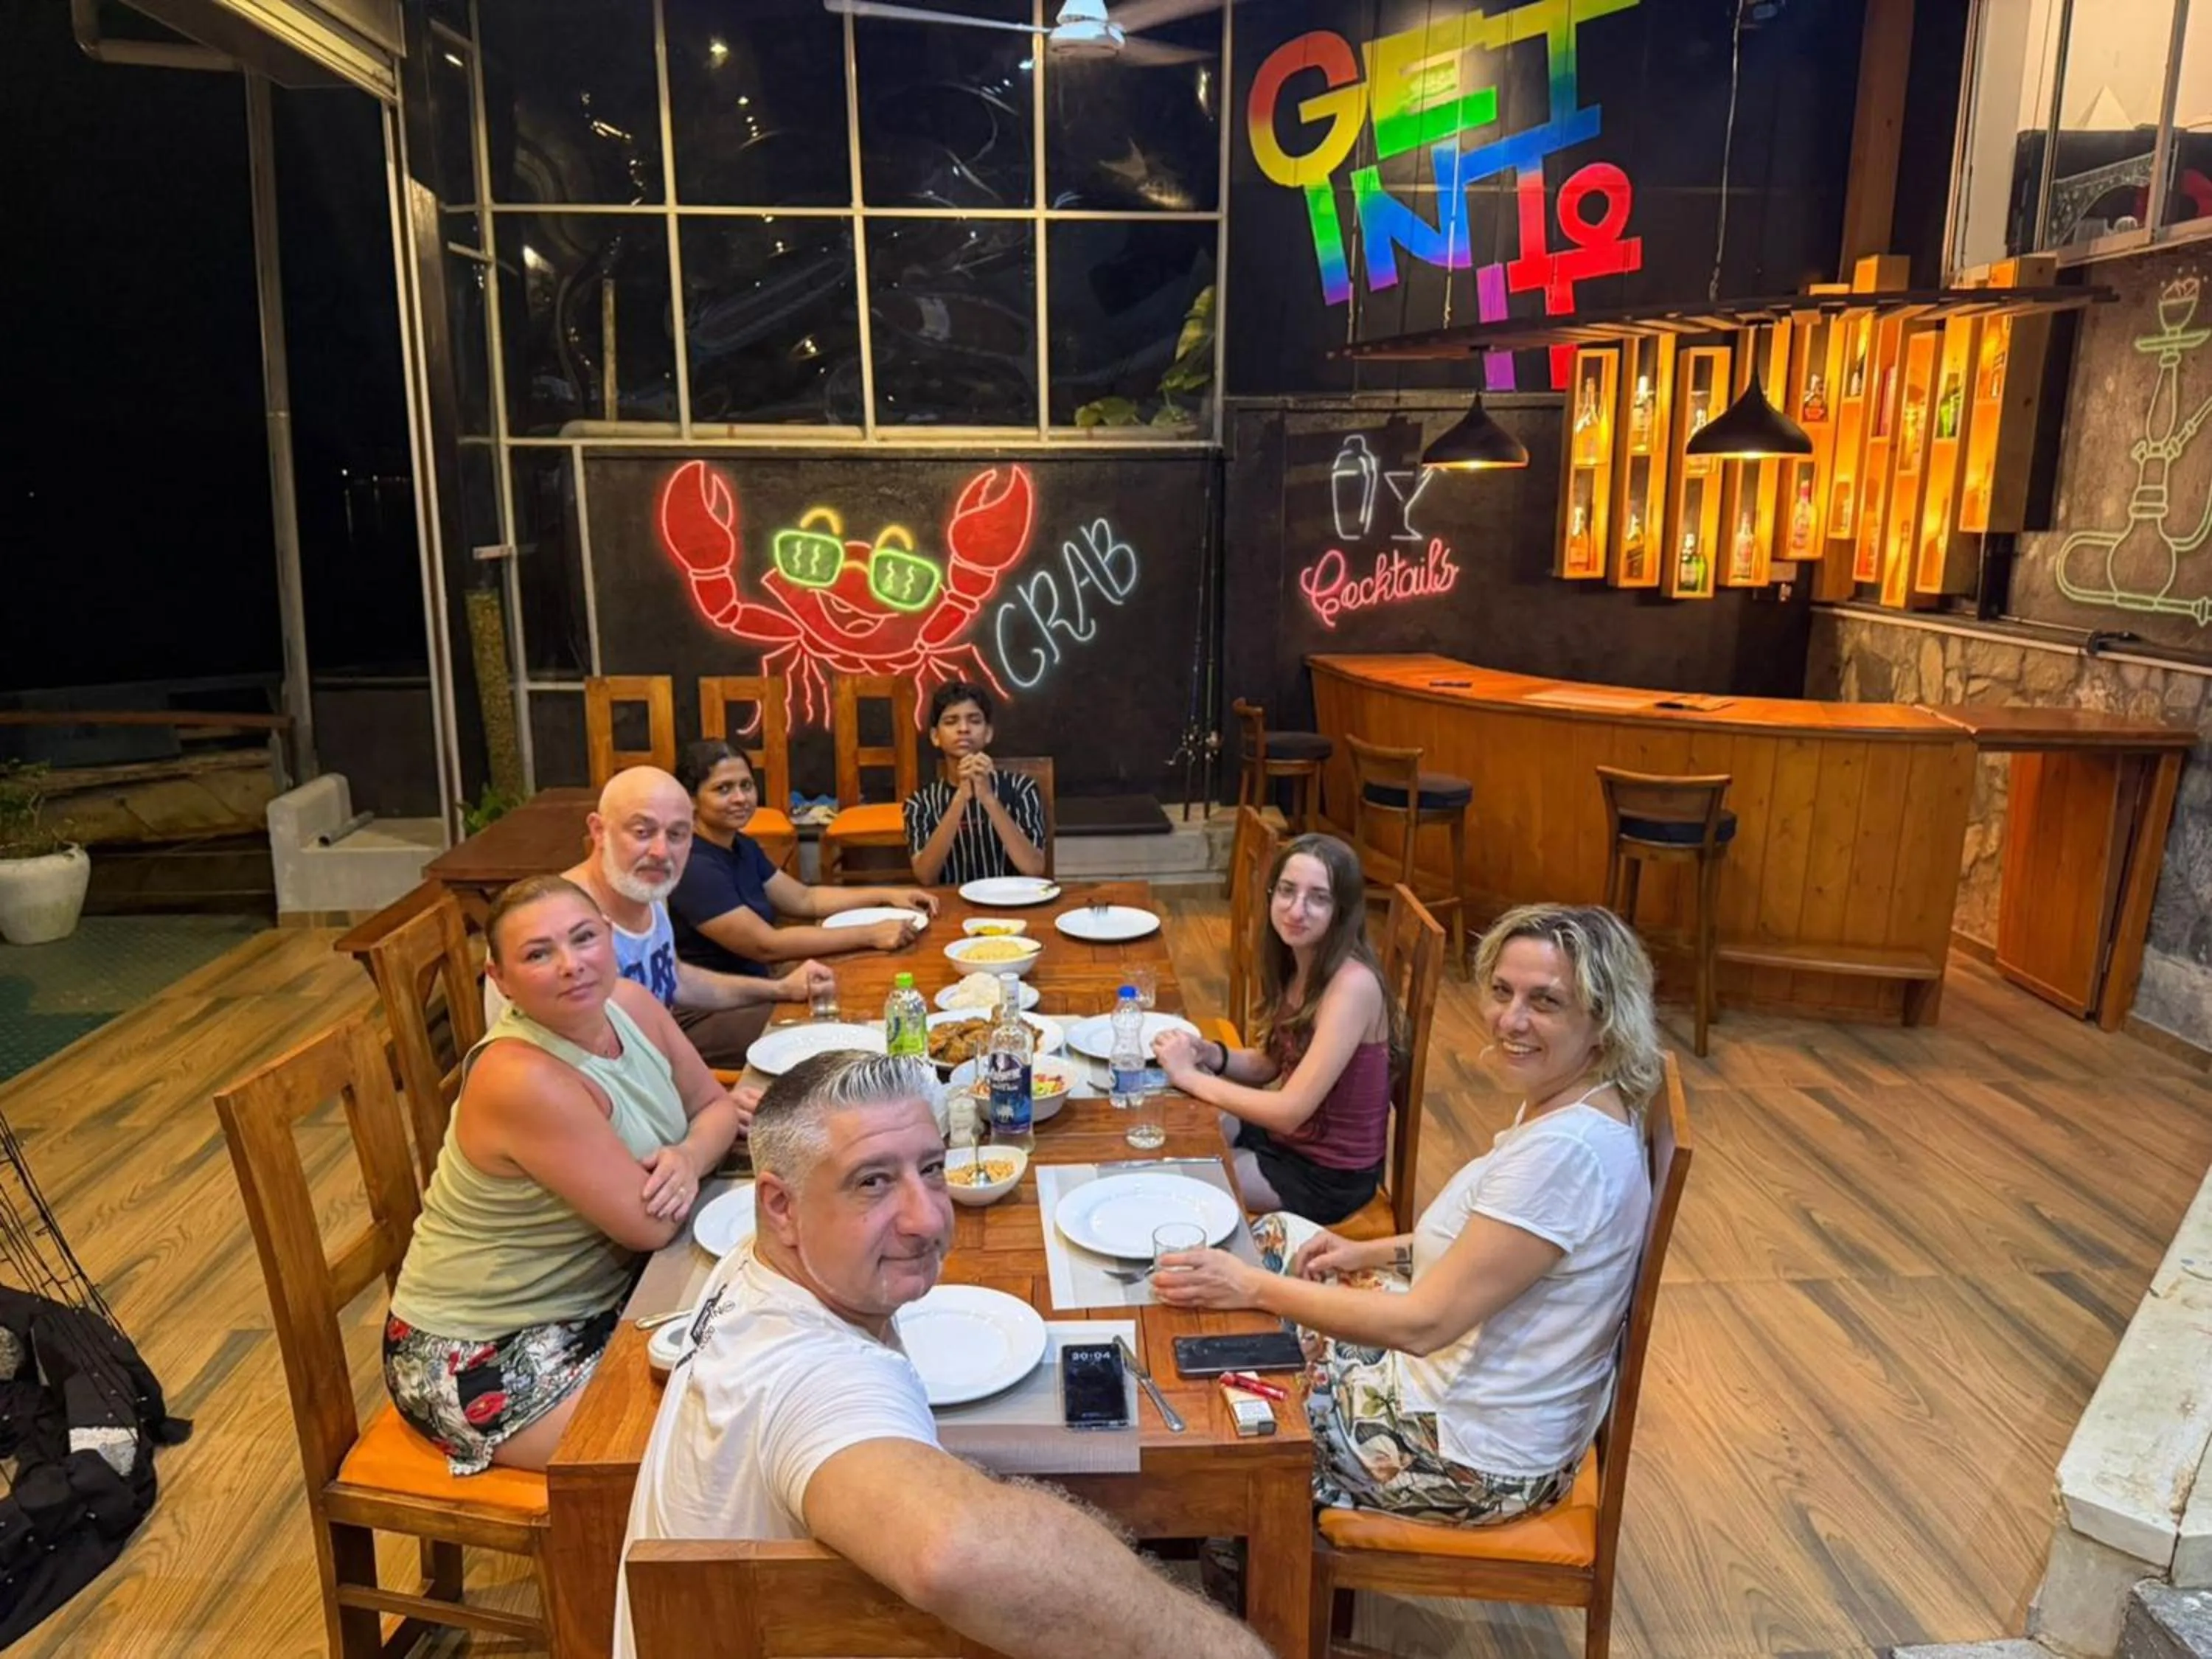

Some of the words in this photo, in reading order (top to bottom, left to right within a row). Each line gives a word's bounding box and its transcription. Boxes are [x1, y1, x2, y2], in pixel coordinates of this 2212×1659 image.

[1248, 0, 1640, 187] GET
[1304, 104, 1632, 306] INTO
[1477, 237, 1642, 390] IT
[996, 518, 1137, 687] CRAB
[1301, 538, 1460, 627] Cocktails
